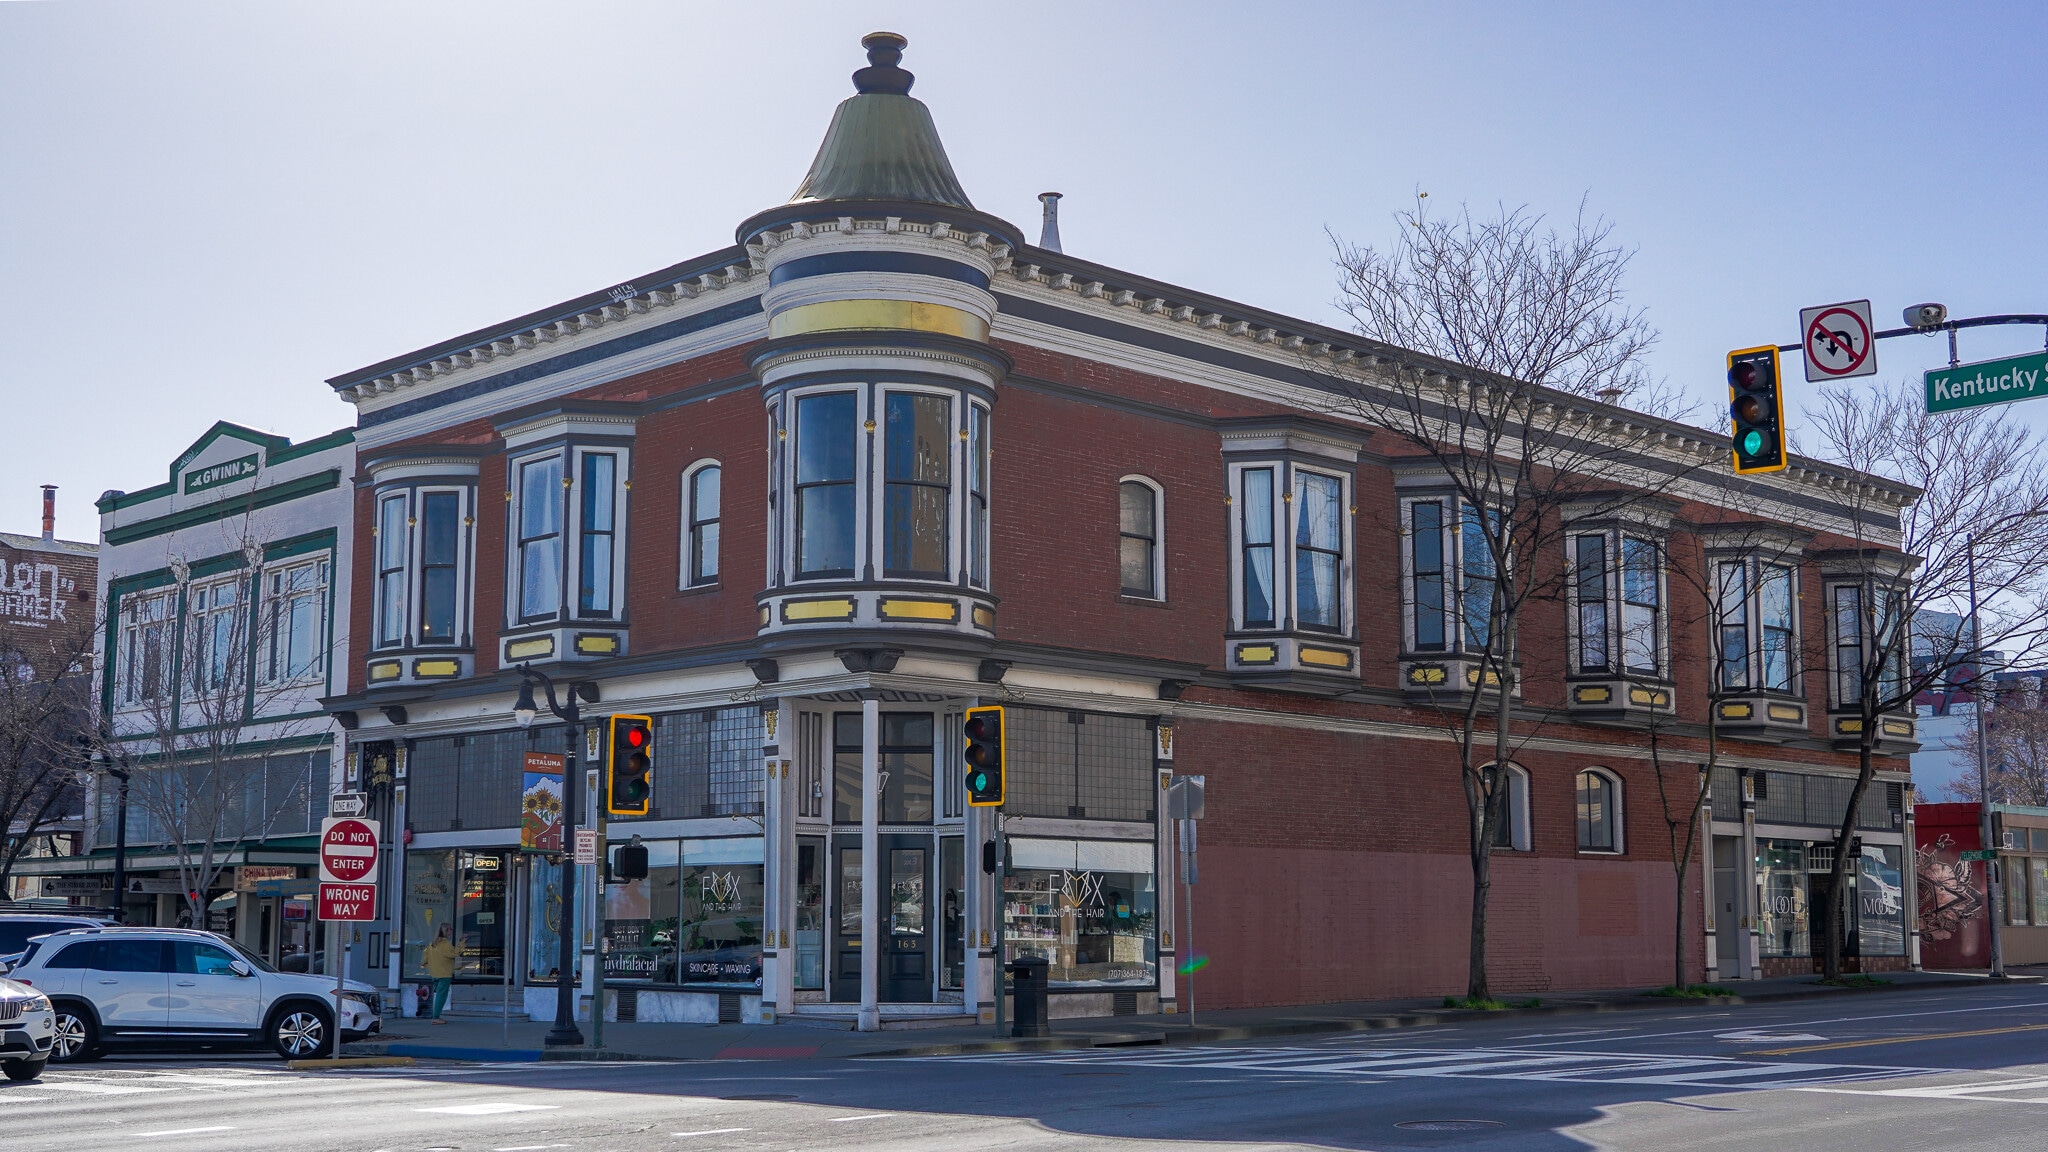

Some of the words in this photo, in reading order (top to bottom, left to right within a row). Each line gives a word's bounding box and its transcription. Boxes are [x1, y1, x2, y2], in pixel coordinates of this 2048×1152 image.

[1934, 366, 2039, 402] Kentucky
[202, 461, 240, 484] GWINN
[527, 758, 562, 767] PETALUMA
[334, 801, 346, 811] ONE
[346, 800, 358, 811] WAY
[330, 831, 345, 842] DO
[350, 832, 371, 843] NOT
[332, 858, 365, 870] ENTER
[244, 868, 265, 878] CHINA
[266, 867, 287, 877] TOWN
[325, 888, 370, 901] WRONG
[333, 903, 360, 916] WAY
[1764, 895, 1803, 914] MOOD
[1864, 897, 1898, 915] MOOD
[1048, 908, 1065, 918] AND
[1068, 908, 1082, 918] THE
[1086, 908, 1105, 918] HAIR
[897, 939, 917, 949] 163
[689, 962, 720, 974] SKINCARE
[724, 963, 752, 975] WAXING
